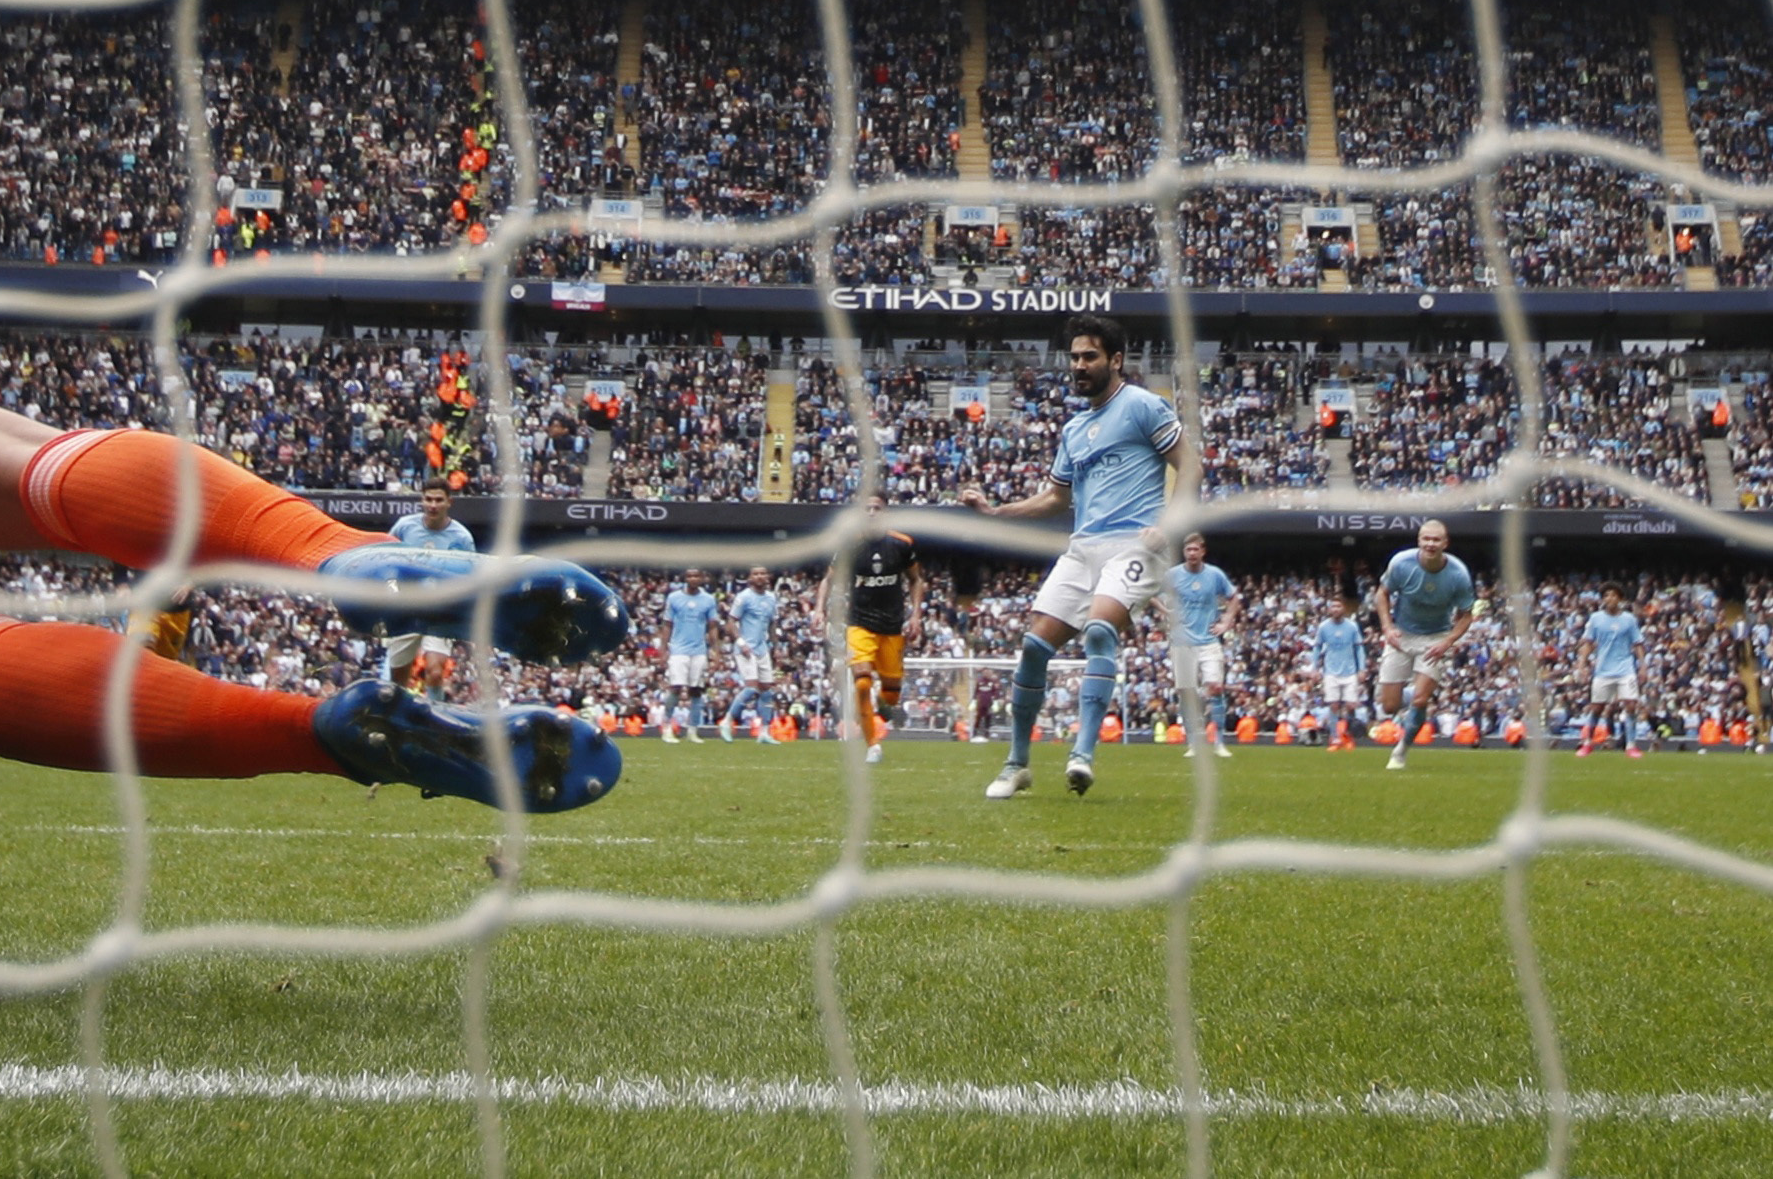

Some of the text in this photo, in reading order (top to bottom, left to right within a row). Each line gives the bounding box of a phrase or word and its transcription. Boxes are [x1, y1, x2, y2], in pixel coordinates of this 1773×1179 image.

[829, 286, 1112, 313] ETIHAD STADIUM
[327, 498, 423, 514] NEXEN TIRE
[566, 504, 669, 521] ETIHAD
[1317, 514, 1427, 530] NISSAN
[1602, 520, 1676, 534] abu dhabi
[1124, 560, 1144, 583] 8
